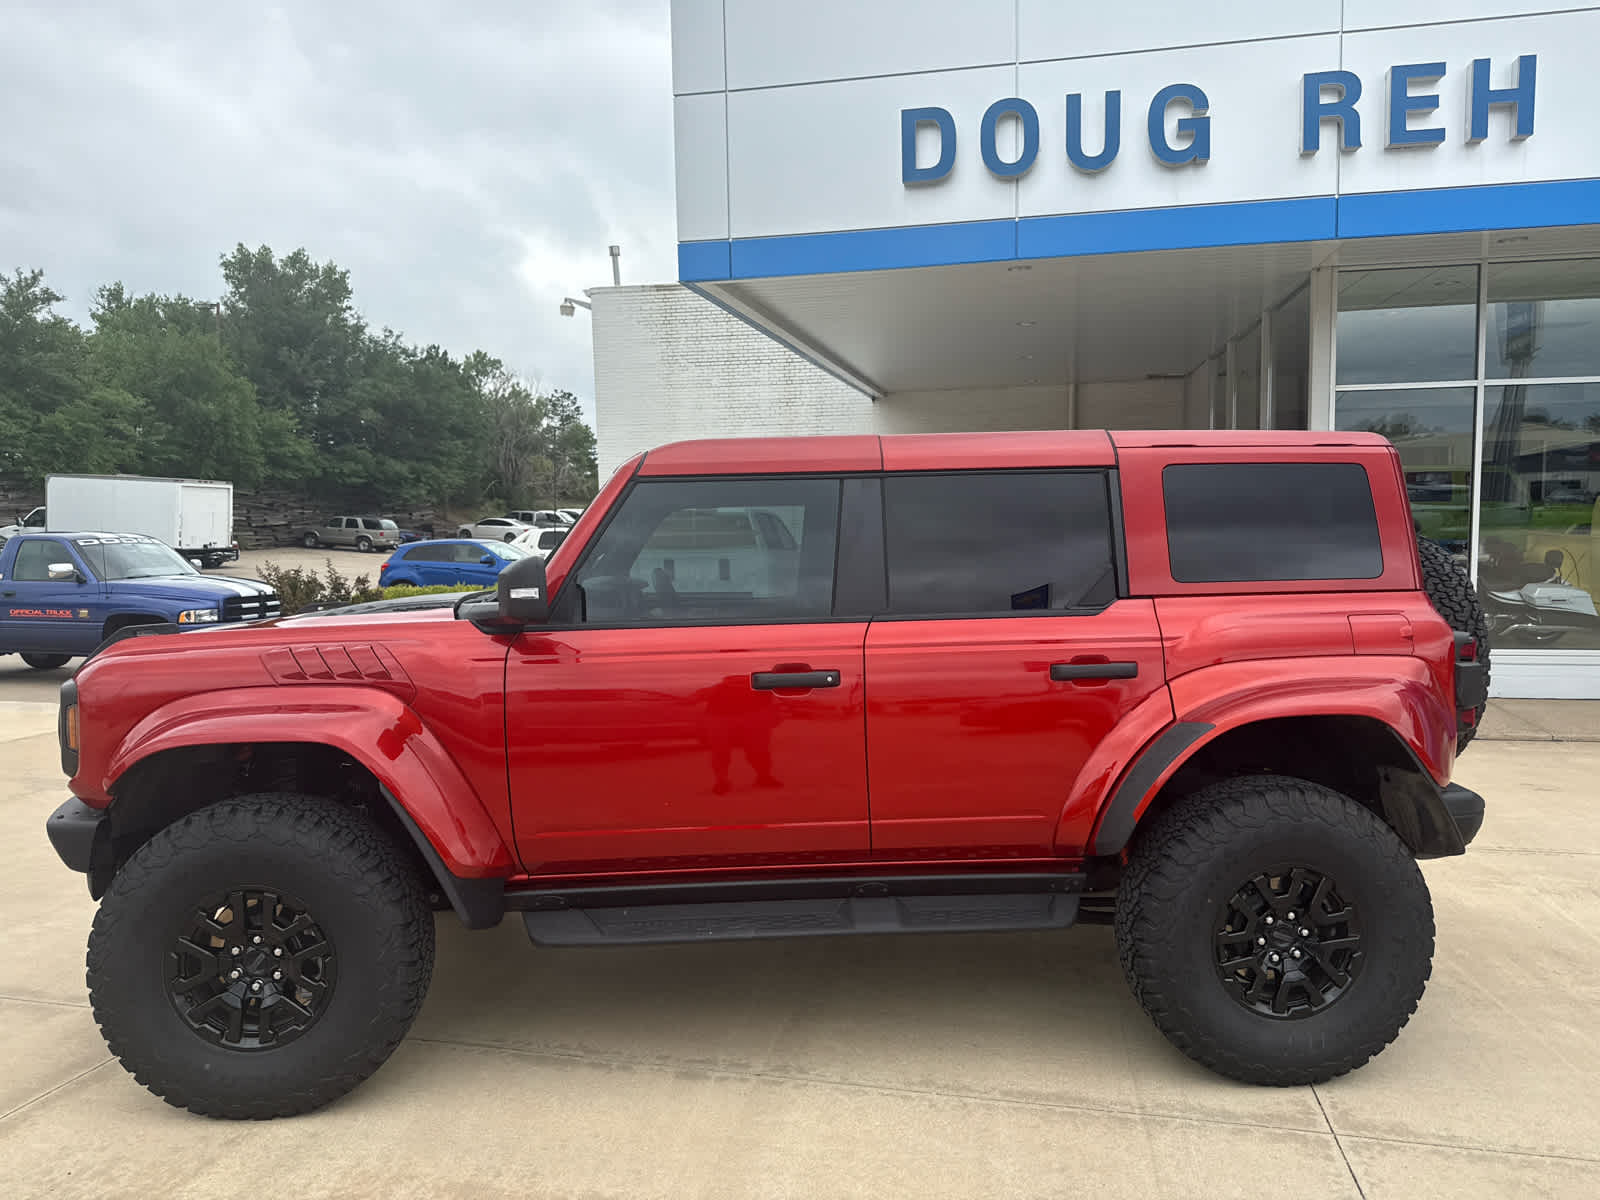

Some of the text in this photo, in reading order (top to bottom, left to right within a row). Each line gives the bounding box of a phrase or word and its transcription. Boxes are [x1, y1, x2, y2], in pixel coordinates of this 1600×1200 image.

[901, 54, 1537, 186] DOUG REH
[46, 609, 72, 617] TRUCK
